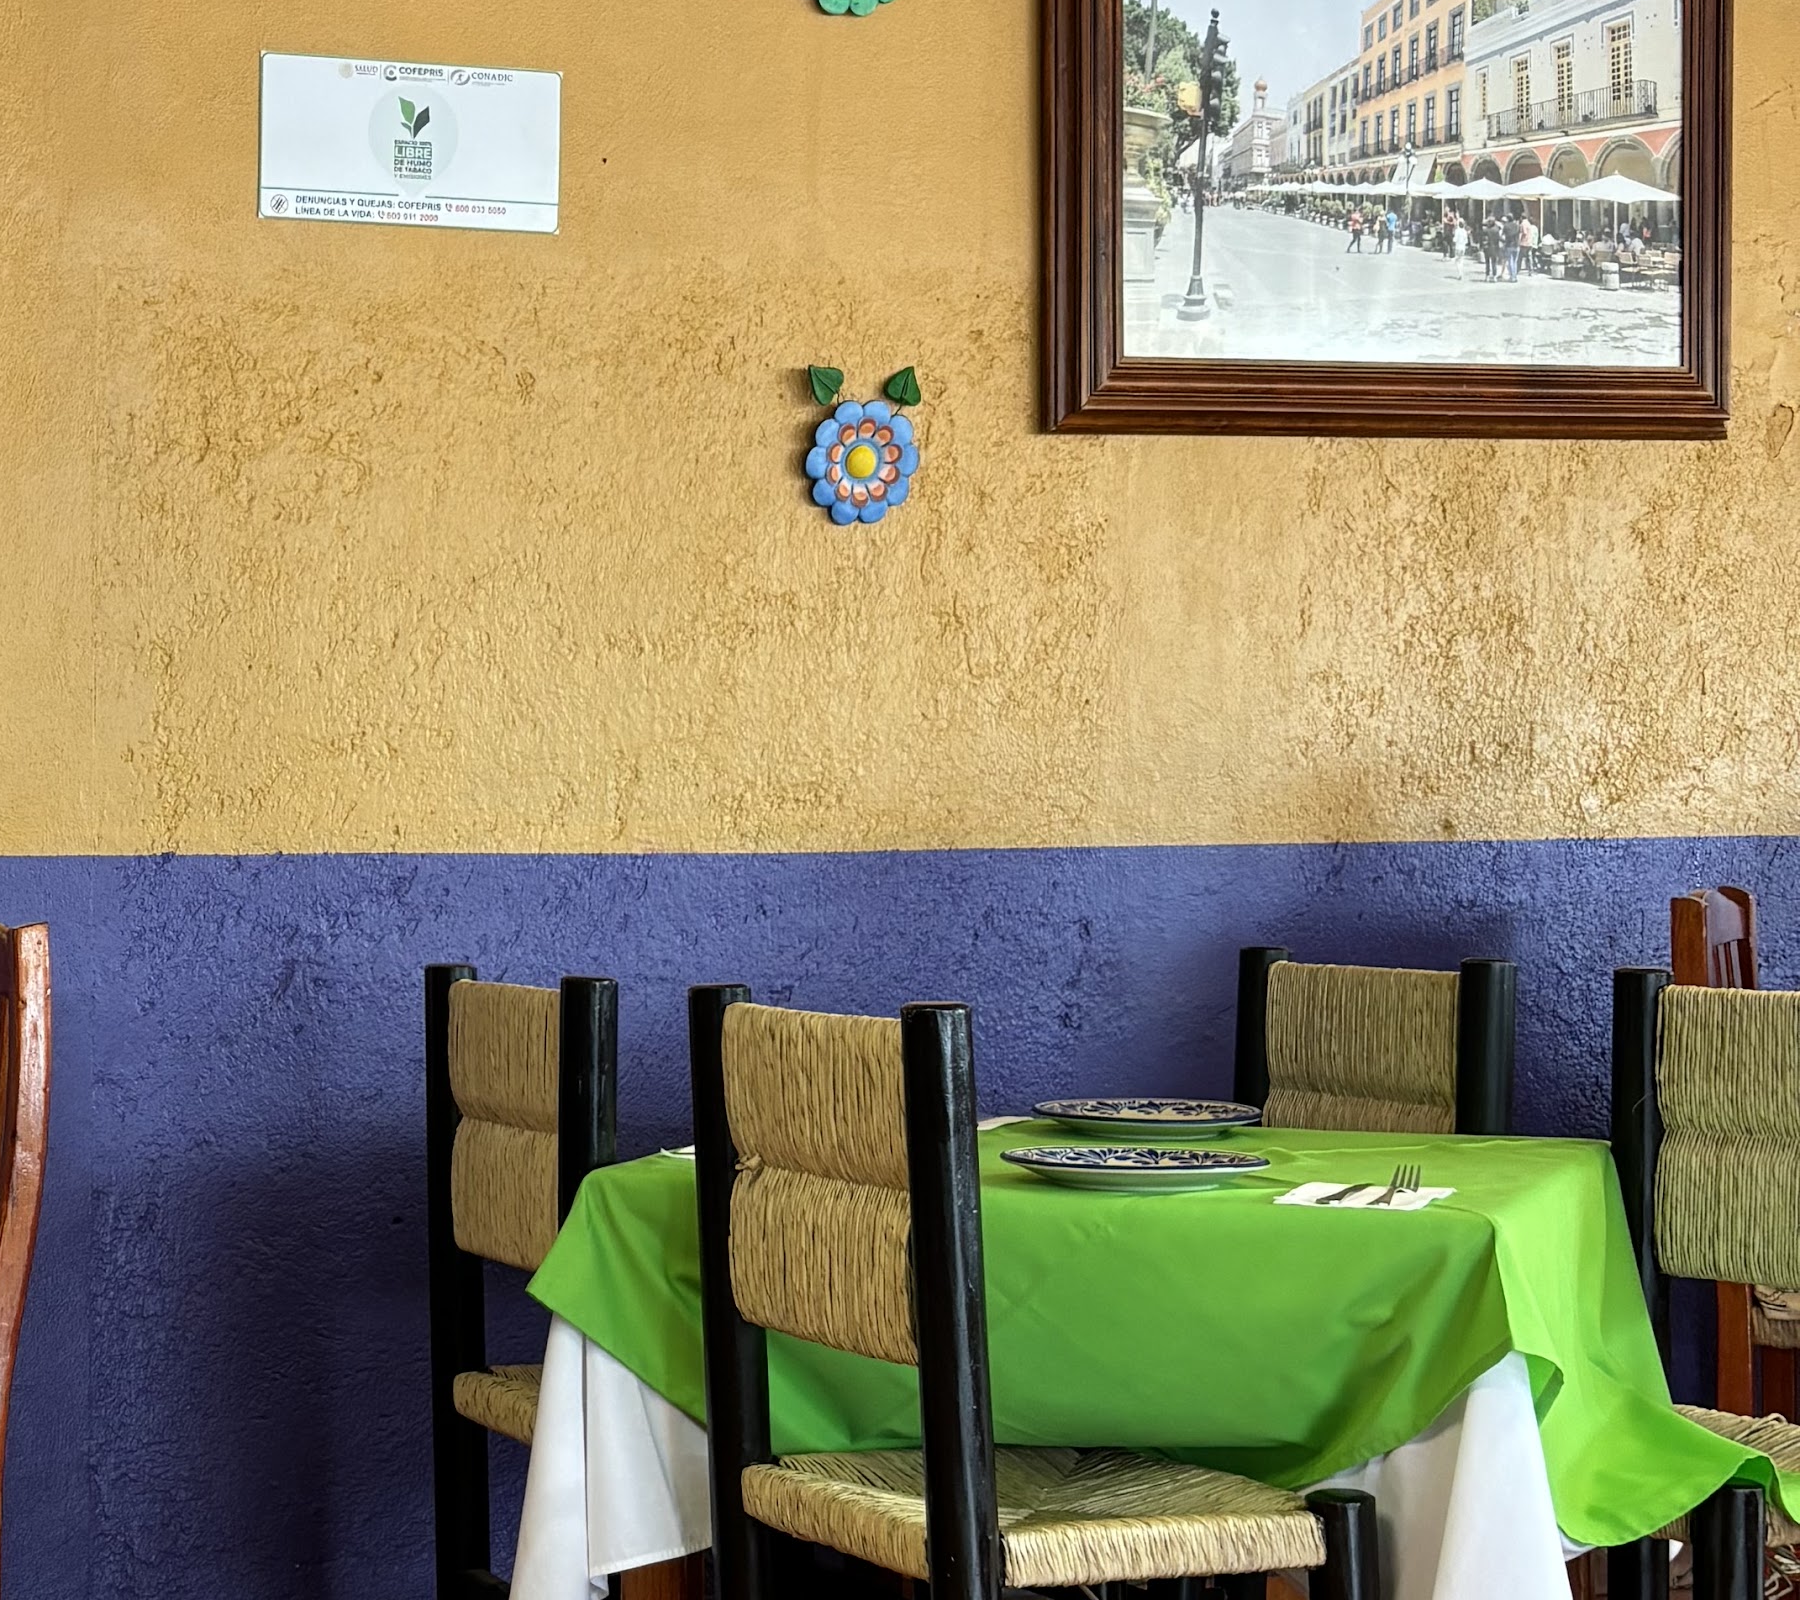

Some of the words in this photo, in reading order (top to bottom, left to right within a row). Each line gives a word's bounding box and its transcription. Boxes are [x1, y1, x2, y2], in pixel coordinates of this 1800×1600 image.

[399, 67, 444, 77] COFEPRIS
[471, 72, 513, 82] CONADIC
[395, 146, 432, 159] LIBRE
[295, 195, 347, 206] DENUNCIAS
[357, 199, 395, 209] QUEJAS:
[398, 201, 442, 211] COFEPRIS
[295, 205, 321, 215] LÍNEA
[323, 208, 335, 216] DE
[337, 209, 349, 217] LA
[351, 210, 375, 218] VIDA:
